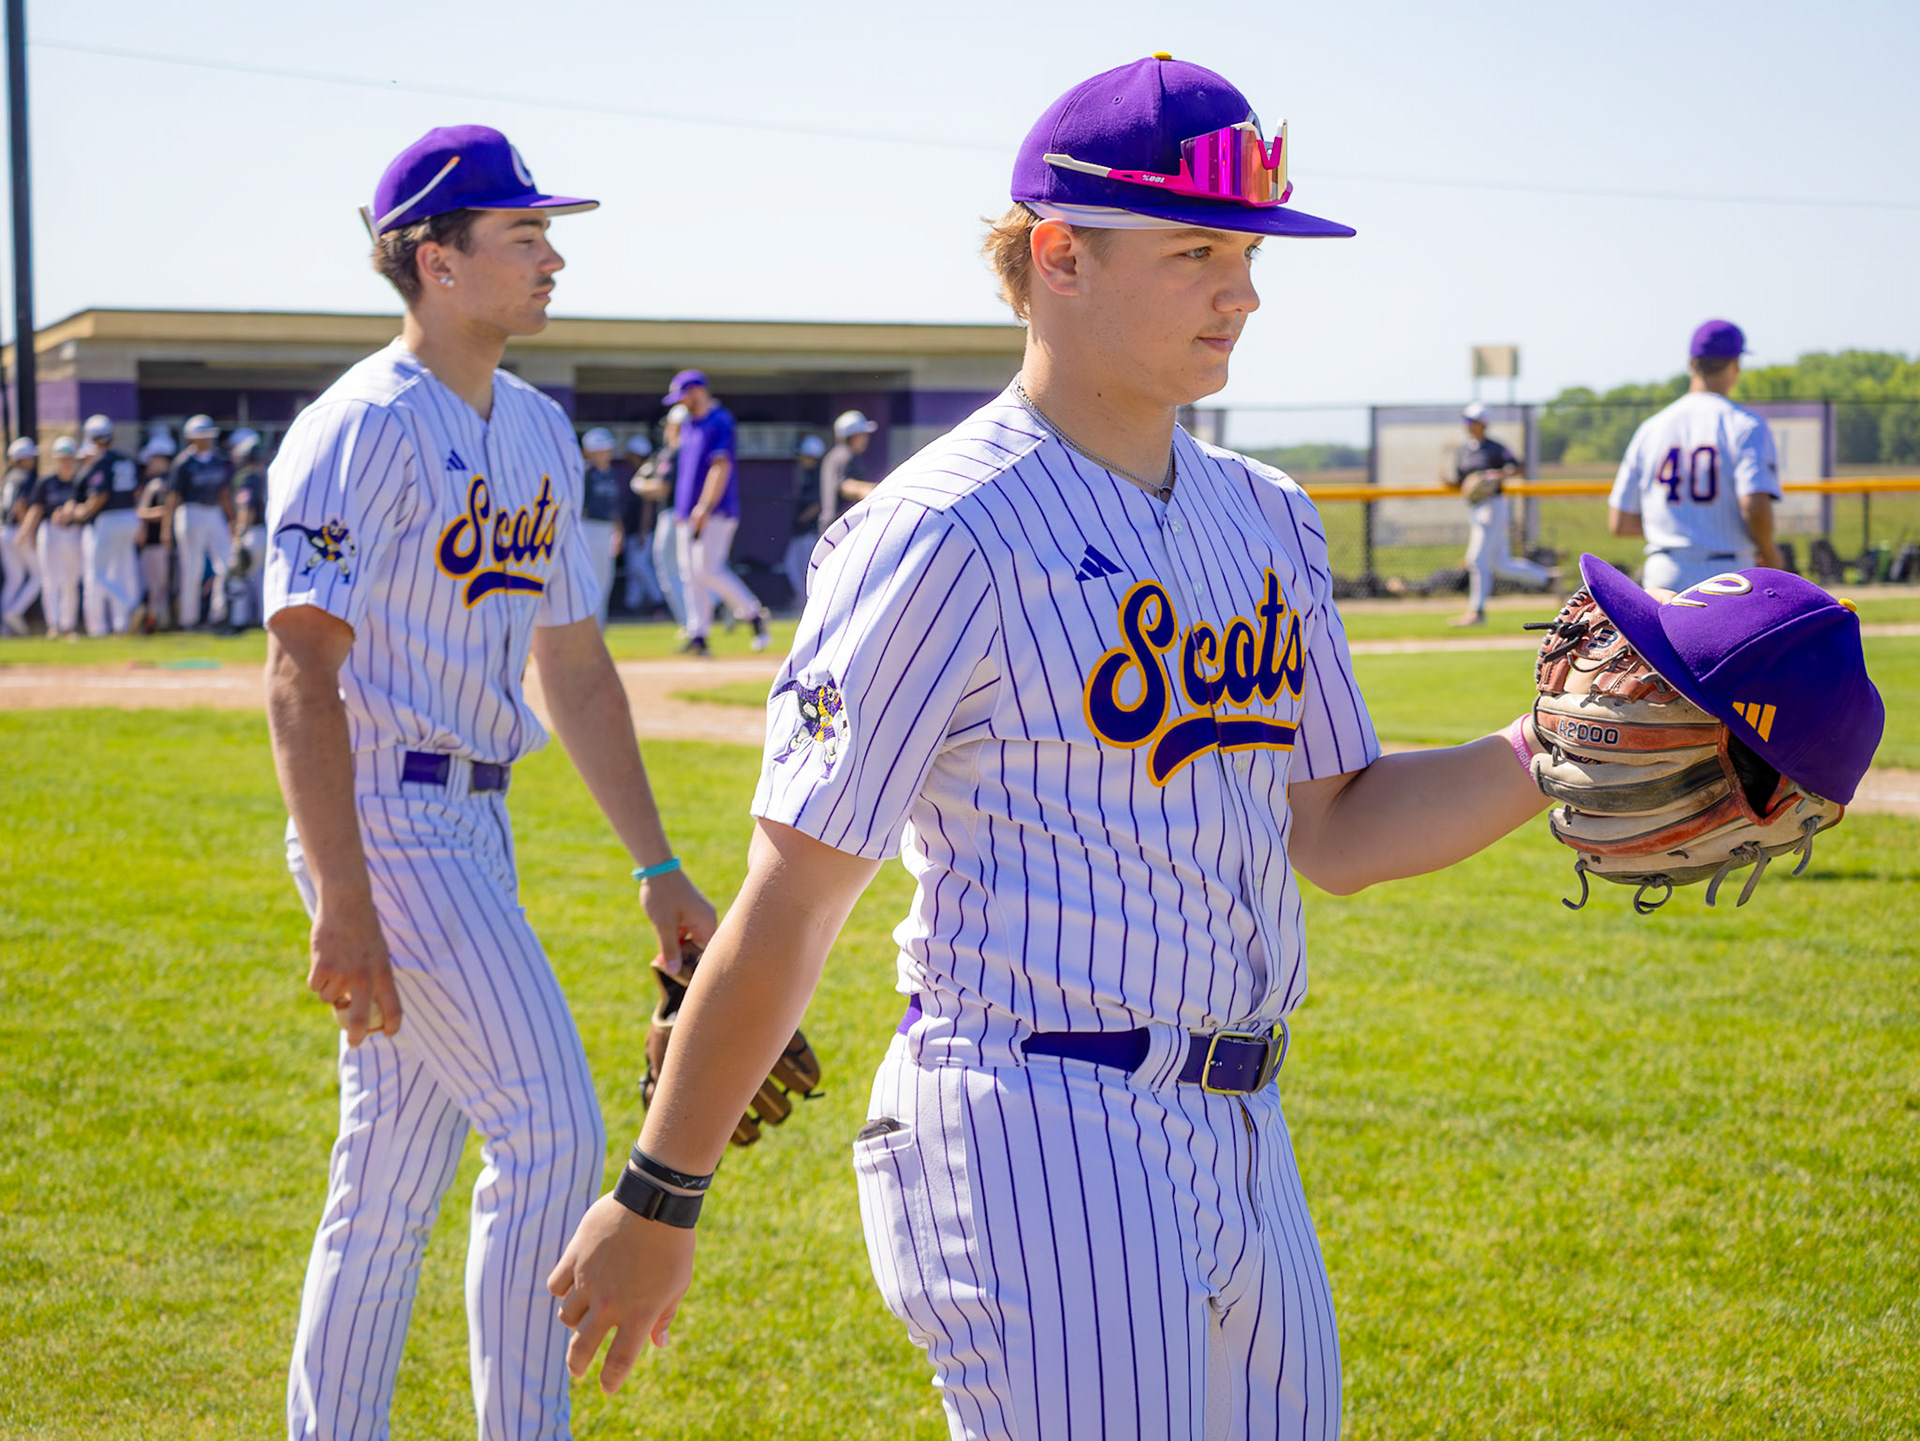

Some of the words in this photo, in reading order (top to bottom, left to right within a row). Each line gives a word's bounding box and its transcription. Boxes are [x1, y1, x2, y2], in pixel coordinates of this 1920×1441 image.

[1657, 446, 1717, 502] 40
[435, 474, 559, 580] Scots
[1083, 567, 1306, 750] Scots
[1558, 718, 1619, 746] A2000
